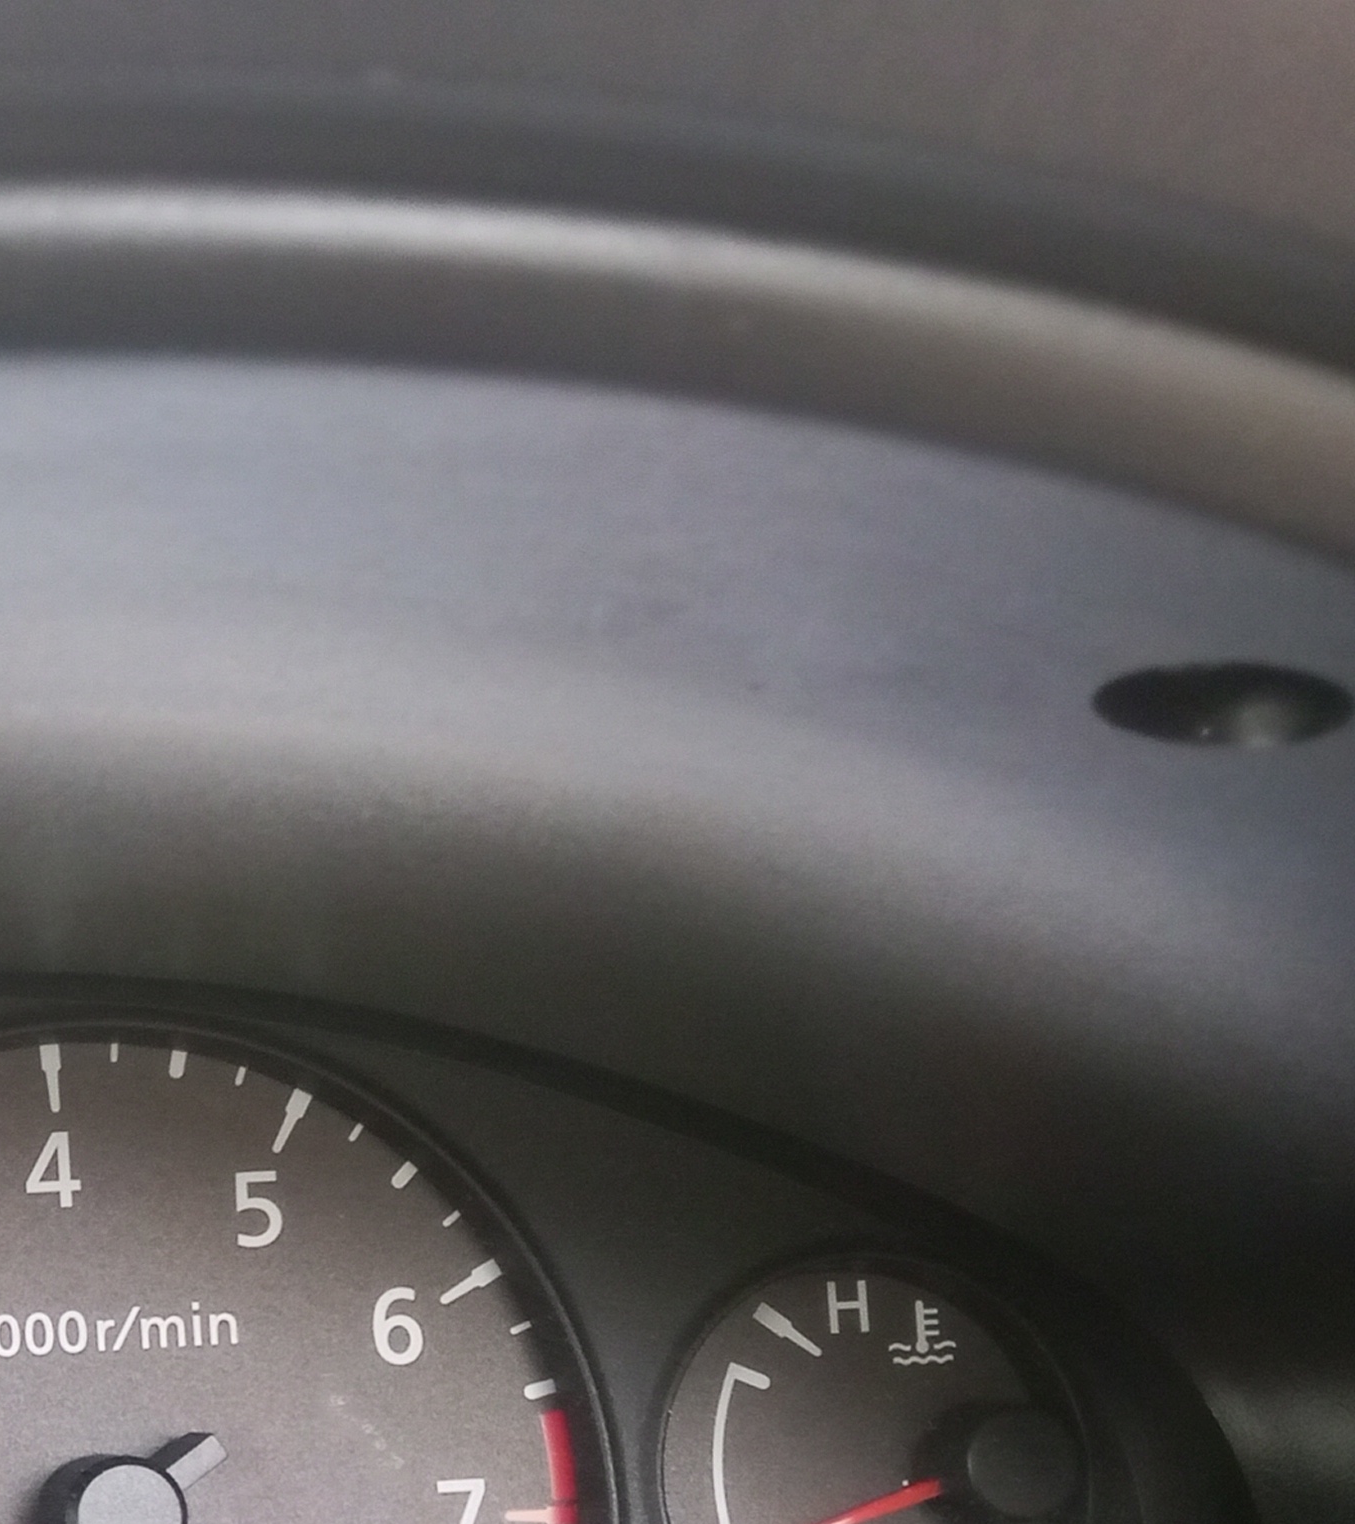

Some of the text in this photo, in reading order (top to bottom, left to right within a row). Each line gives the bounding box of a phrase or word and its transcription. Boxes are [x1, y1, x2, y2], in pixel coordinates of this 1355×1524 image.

[26, 1131, 82, 1208] 4
[233, 1170, 284, 1248] 5
[371, 1286, 425, 1365] 6
[826, 1280, 870, 1334] H
